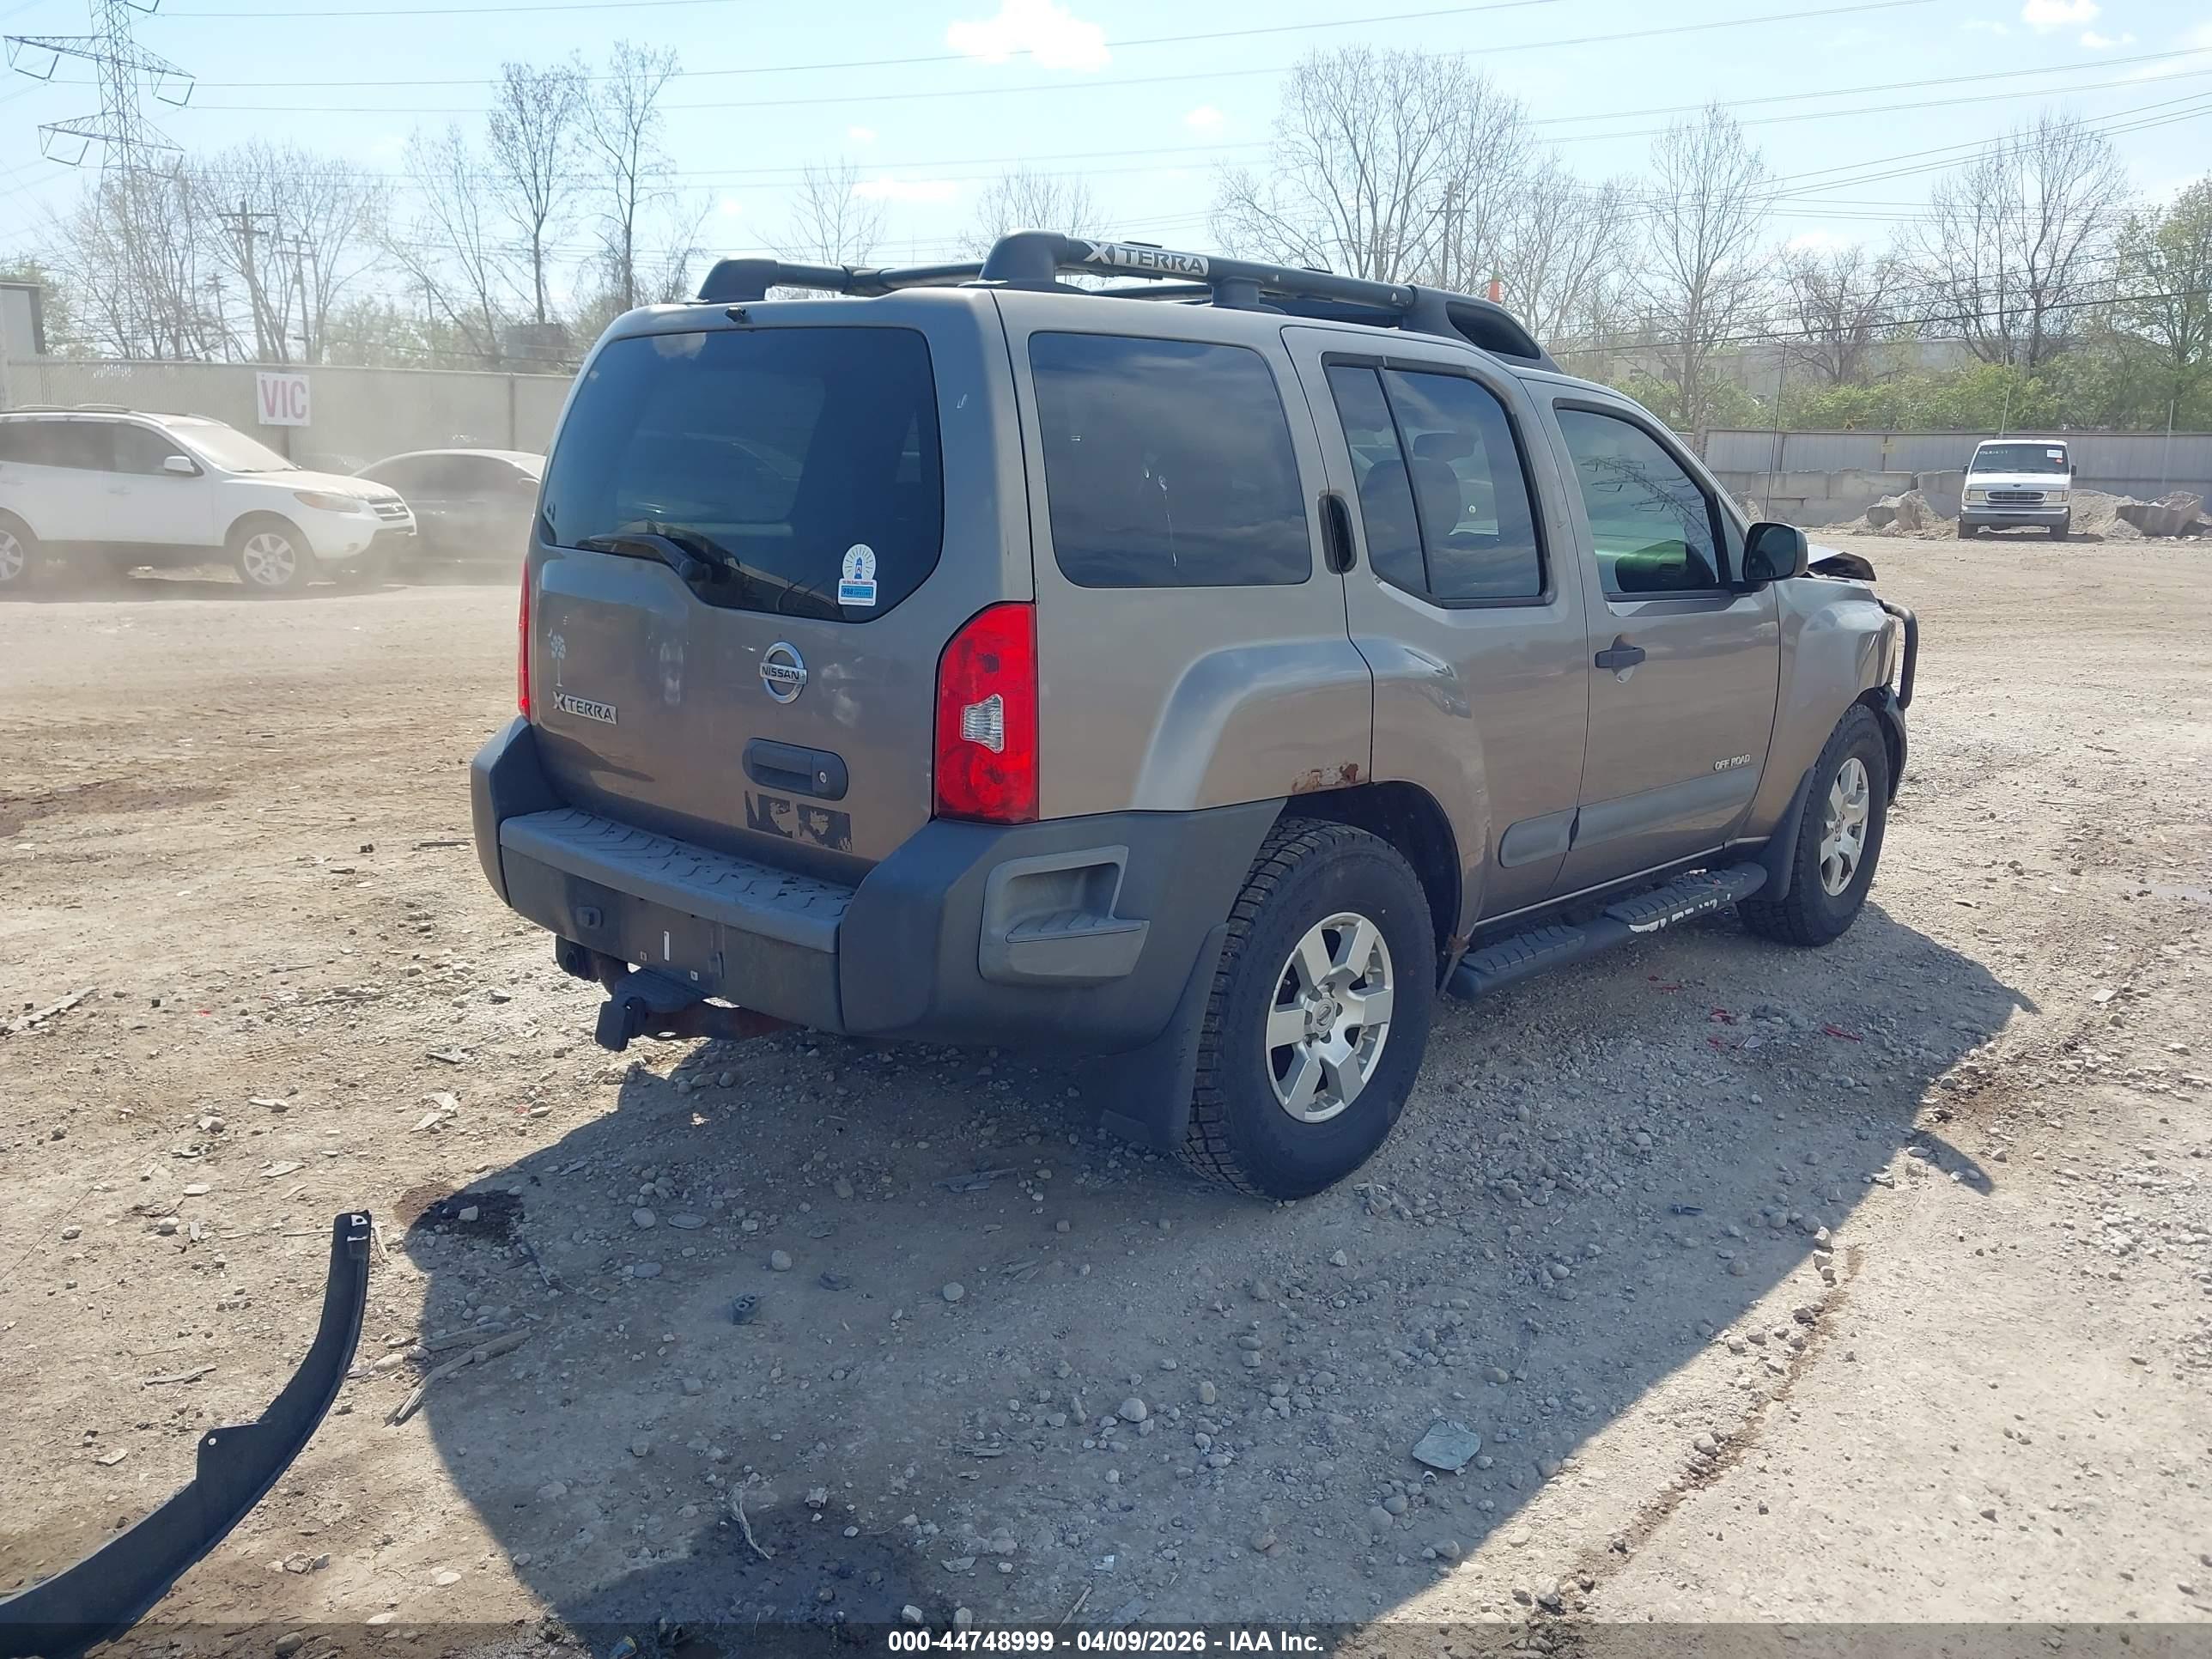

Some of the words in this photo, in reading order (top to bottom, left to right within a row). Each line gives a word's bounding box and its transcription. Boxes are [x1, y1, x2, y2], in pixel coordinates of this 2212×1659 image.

[1082, 240, 1207, 276] XTERRA
[260, 379, 307, 419] VIC
[761, 665, 801, 682] NISSAN
[552, 690, 617, 725] XTERRA
[1714, 760, 1730, 771] OFF
[1730, 754, 1752, 768] ROAD
